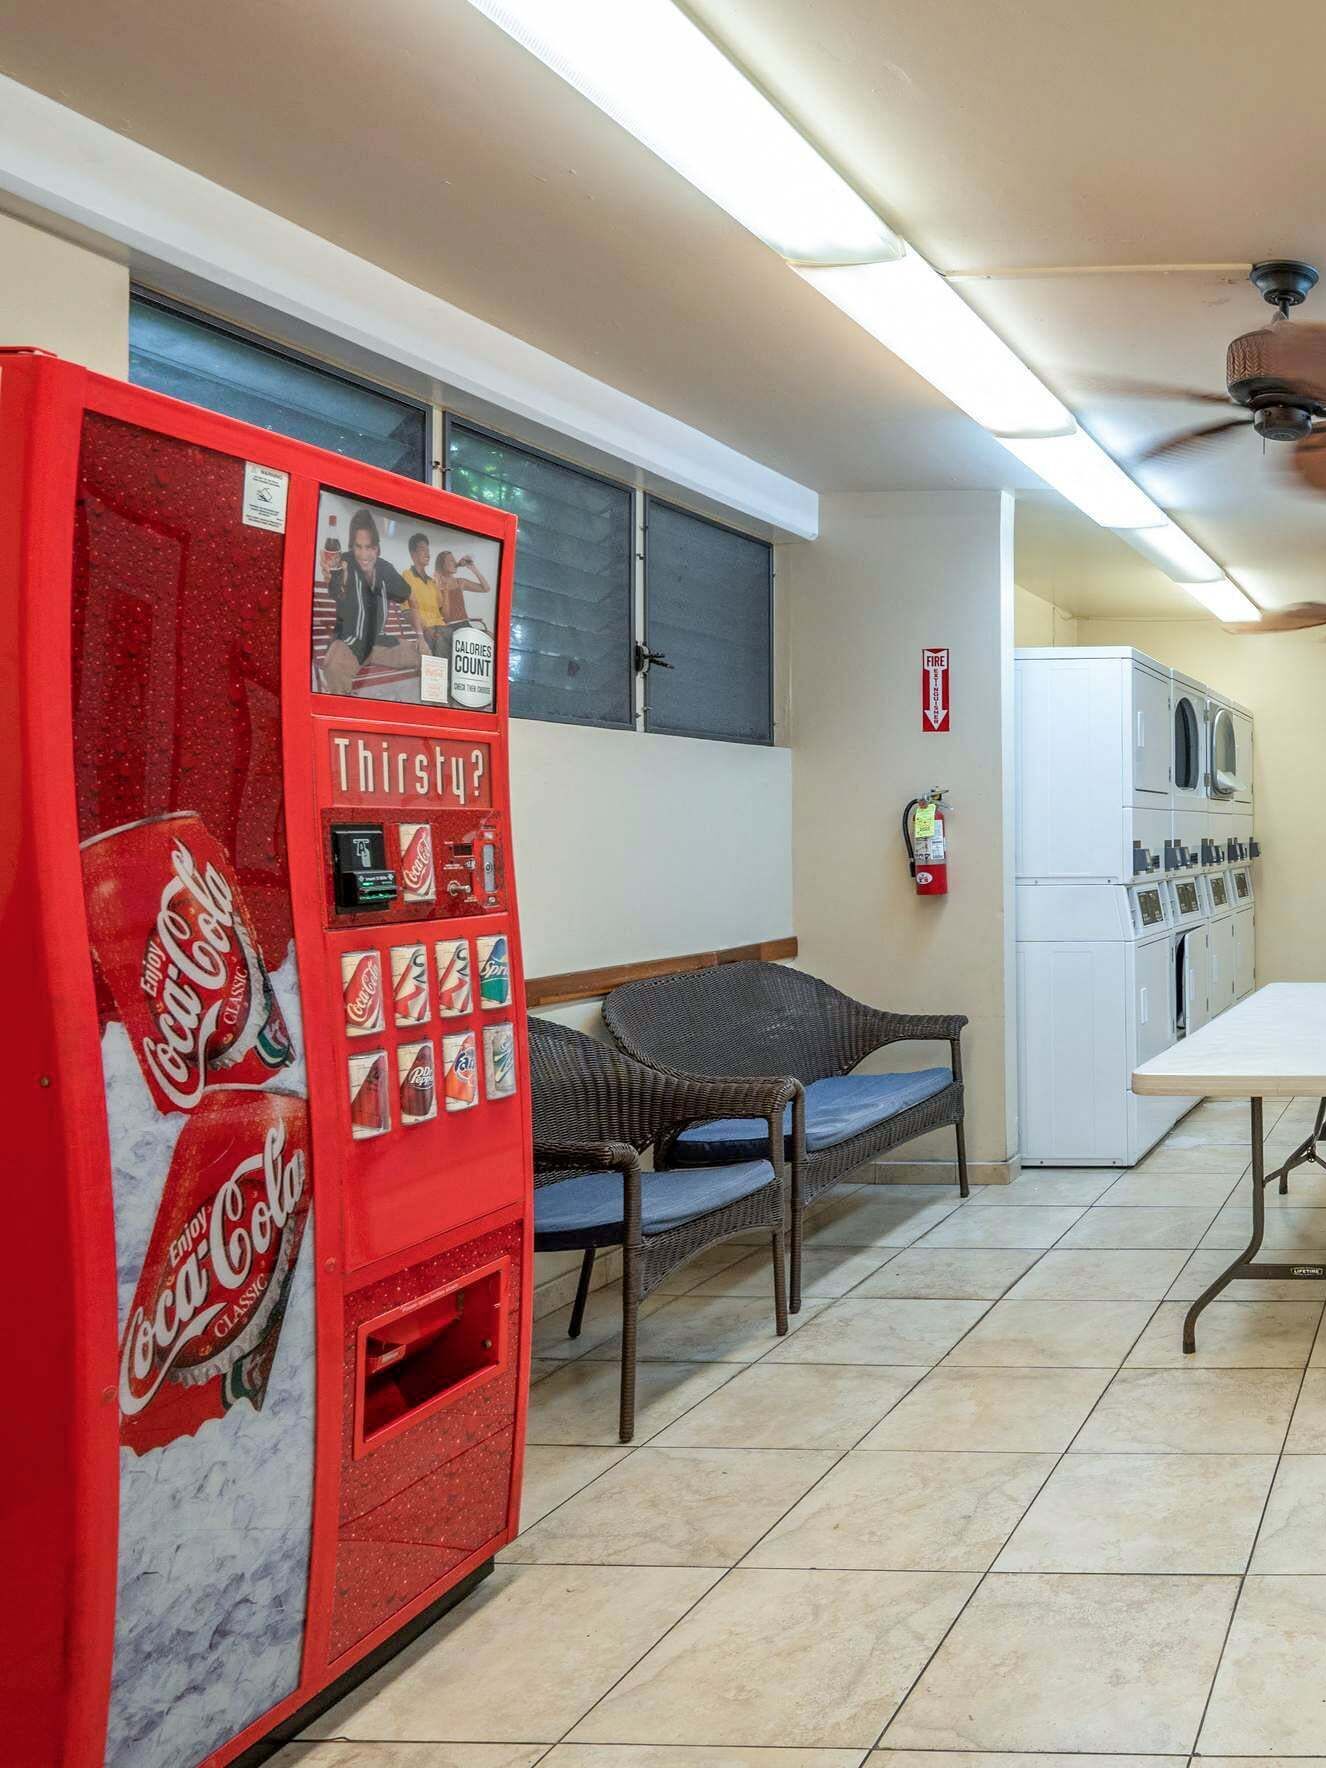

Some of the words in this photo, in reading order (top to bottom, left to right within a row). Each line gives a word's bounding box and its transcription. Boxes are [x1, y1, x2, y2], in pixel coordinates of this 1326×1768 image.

[455, 640, 492, 658] CALORIES
[455, 655, 491, 676] COUNT
[926, 655, 945, 667] FIRE
[334, 738, 483, 805] Thirsty?
[140, 940, 166, 998] Enjoy
[143, 836, 233, 1109] Coca-Cola
[223, 965, 248, 1025] CLASSIC
[119, 1117, 305, 1415] Coca-Cola
[168, 1205, 208, 1267] Enjoy
[214, 1272, 268, 1339] CLASSIC
